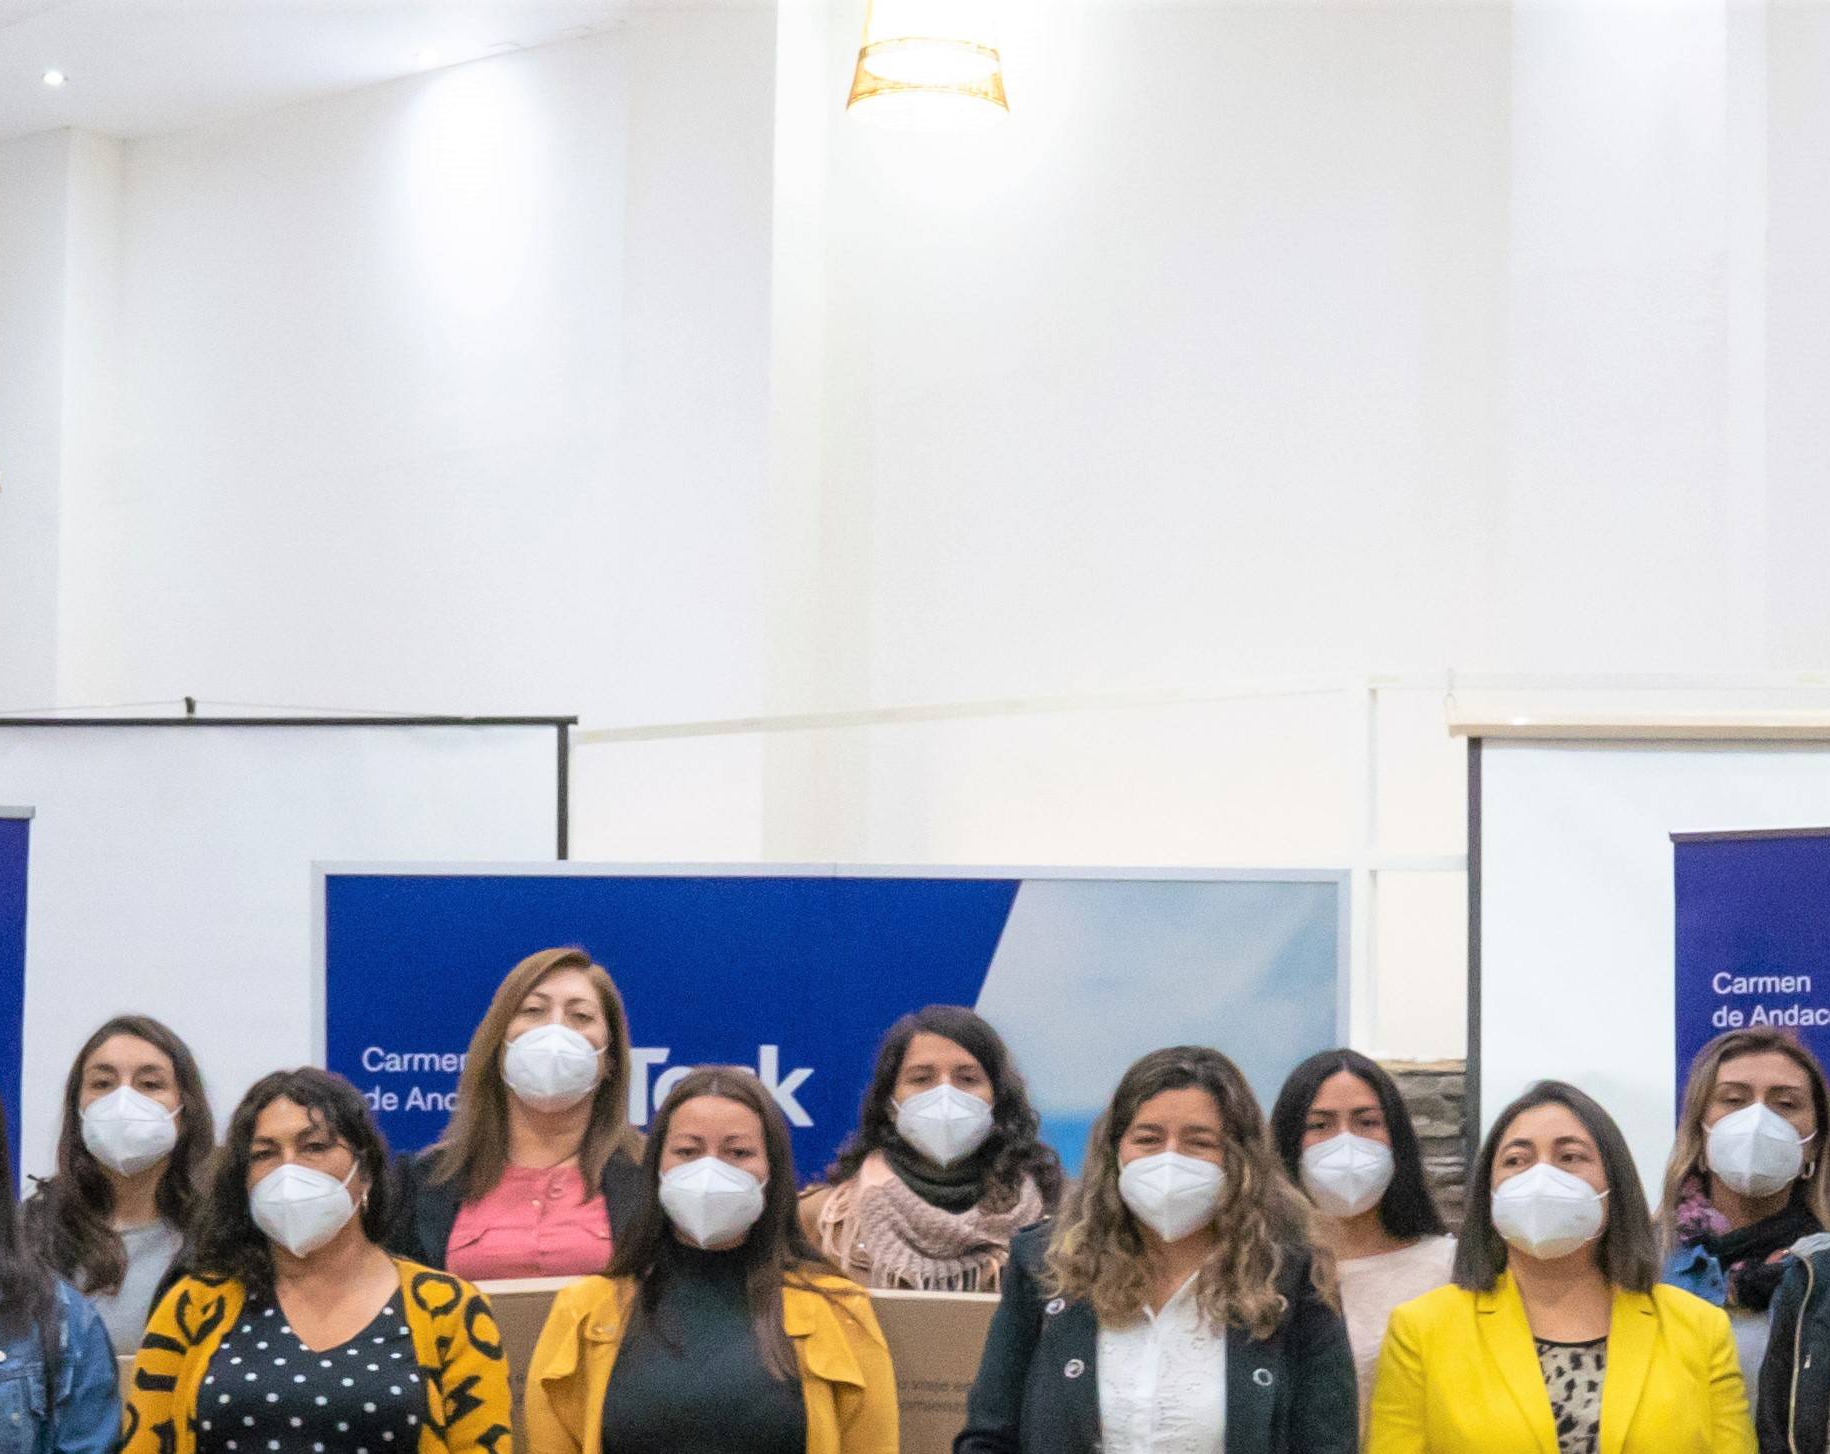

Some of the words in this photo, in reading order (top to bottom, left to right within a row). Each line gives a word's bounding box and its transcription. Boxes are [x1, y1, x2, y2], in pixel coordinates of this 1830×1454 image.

[1711, 971, 1812, 995] Carmen
[1711, 1005, 1745, 1028] de
[363, 1084, 400, 1112] de
[628, 1044, 815, 1128] Tk
